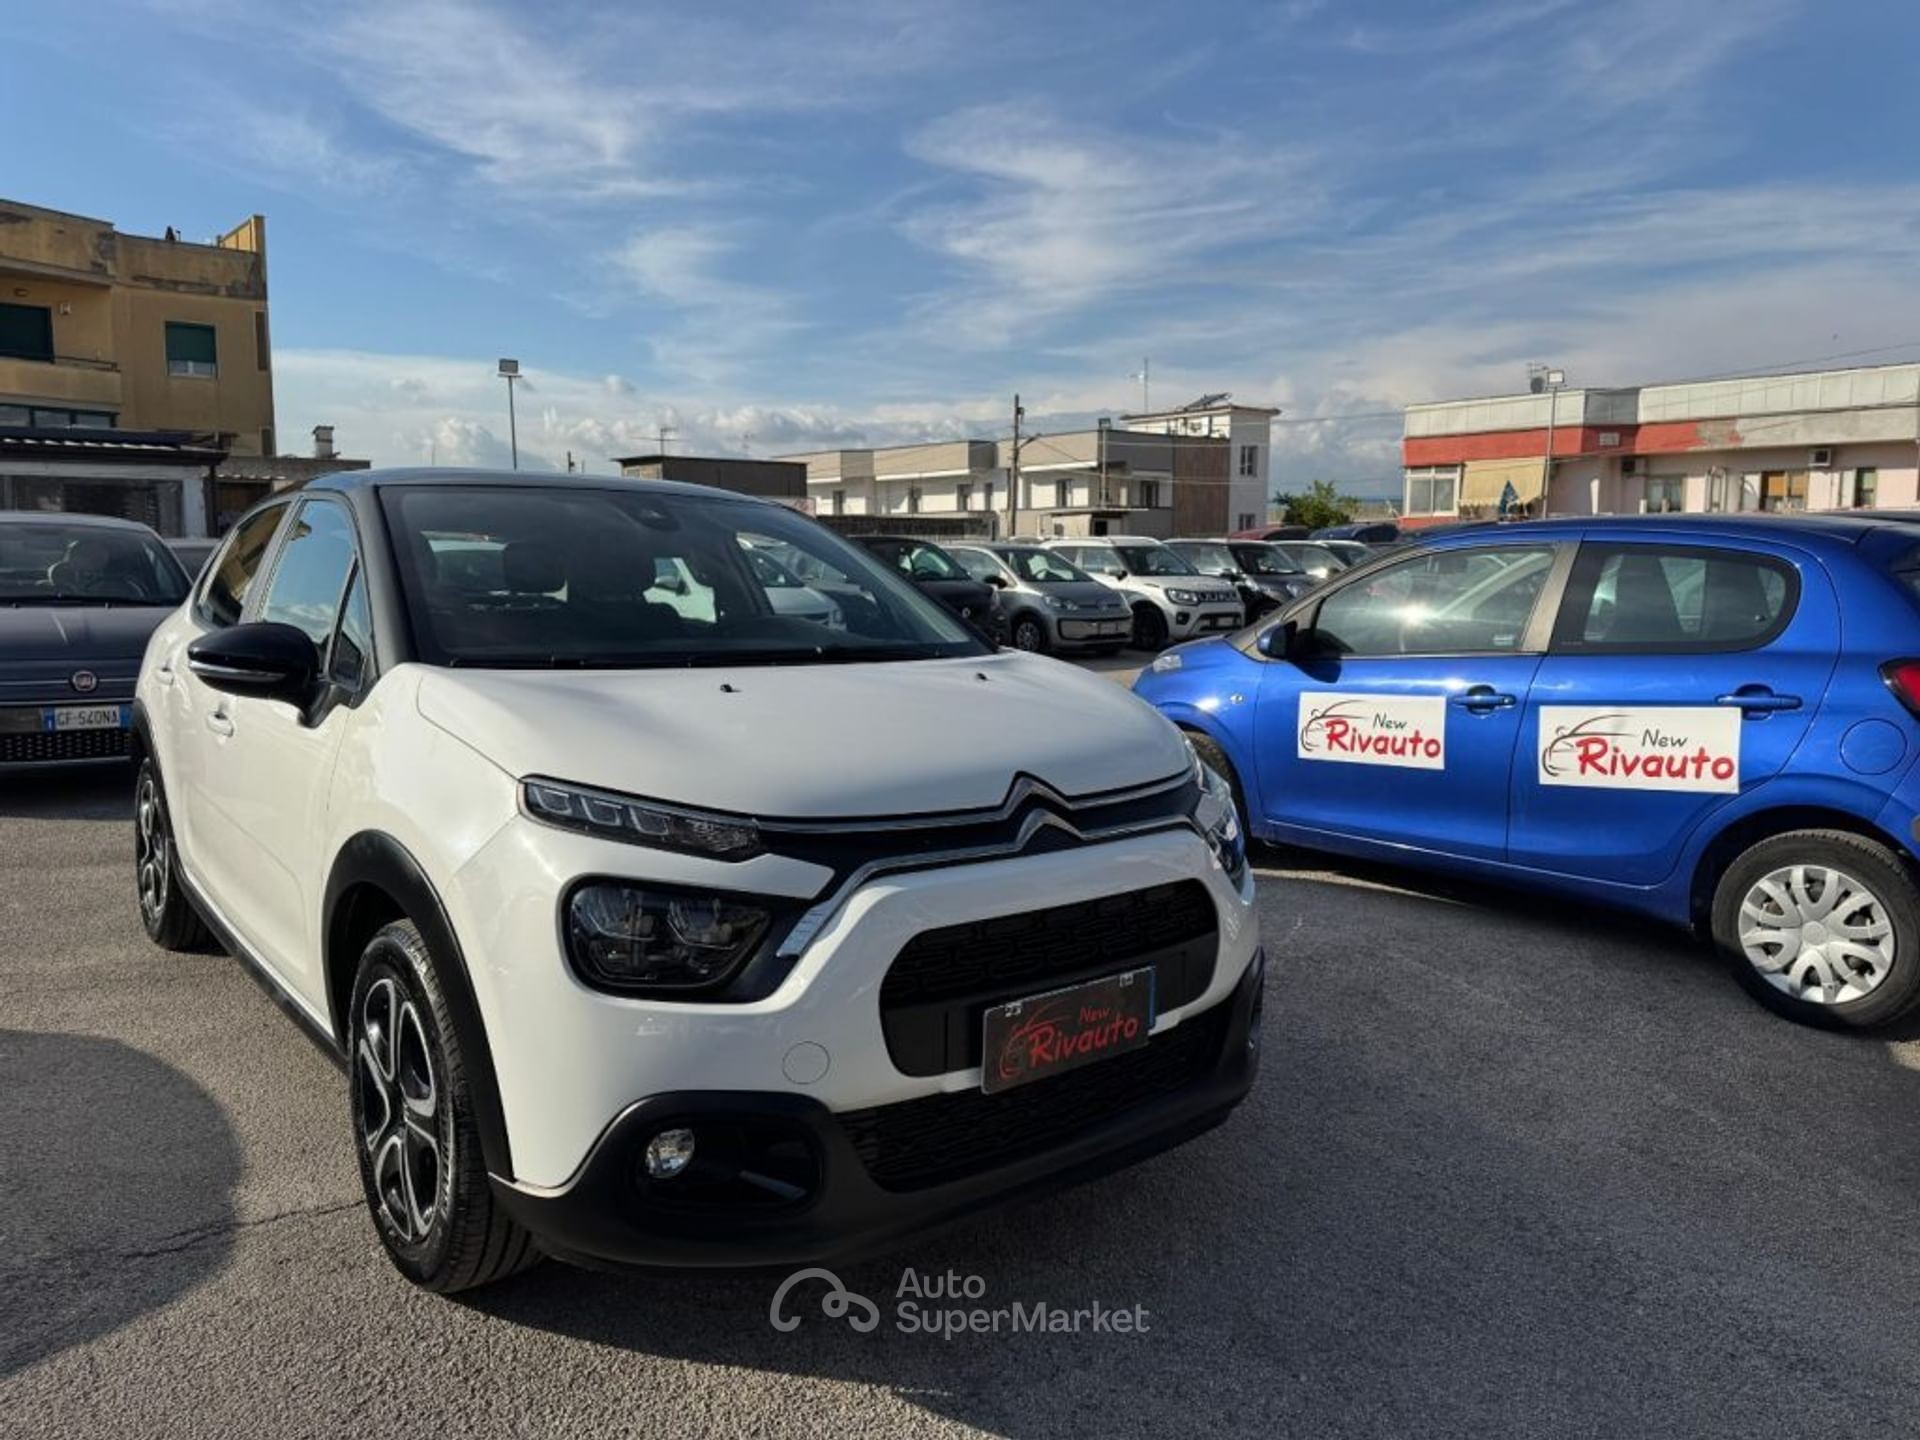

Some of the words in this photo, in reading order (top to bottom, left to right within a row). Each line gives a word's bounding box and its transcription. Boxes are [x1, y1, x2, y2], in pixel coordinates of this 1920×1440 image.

[1372, 712, 1408, 730] New
[1324, 719, 1442, 758] Rivauto
[1641, 728, 1688, 749] New
[1575, 736, 1736, 780] Rivauto
[1080, 1007, 1111, 1023] New
[1029, 1014, 1139, 1067] Rivauto
